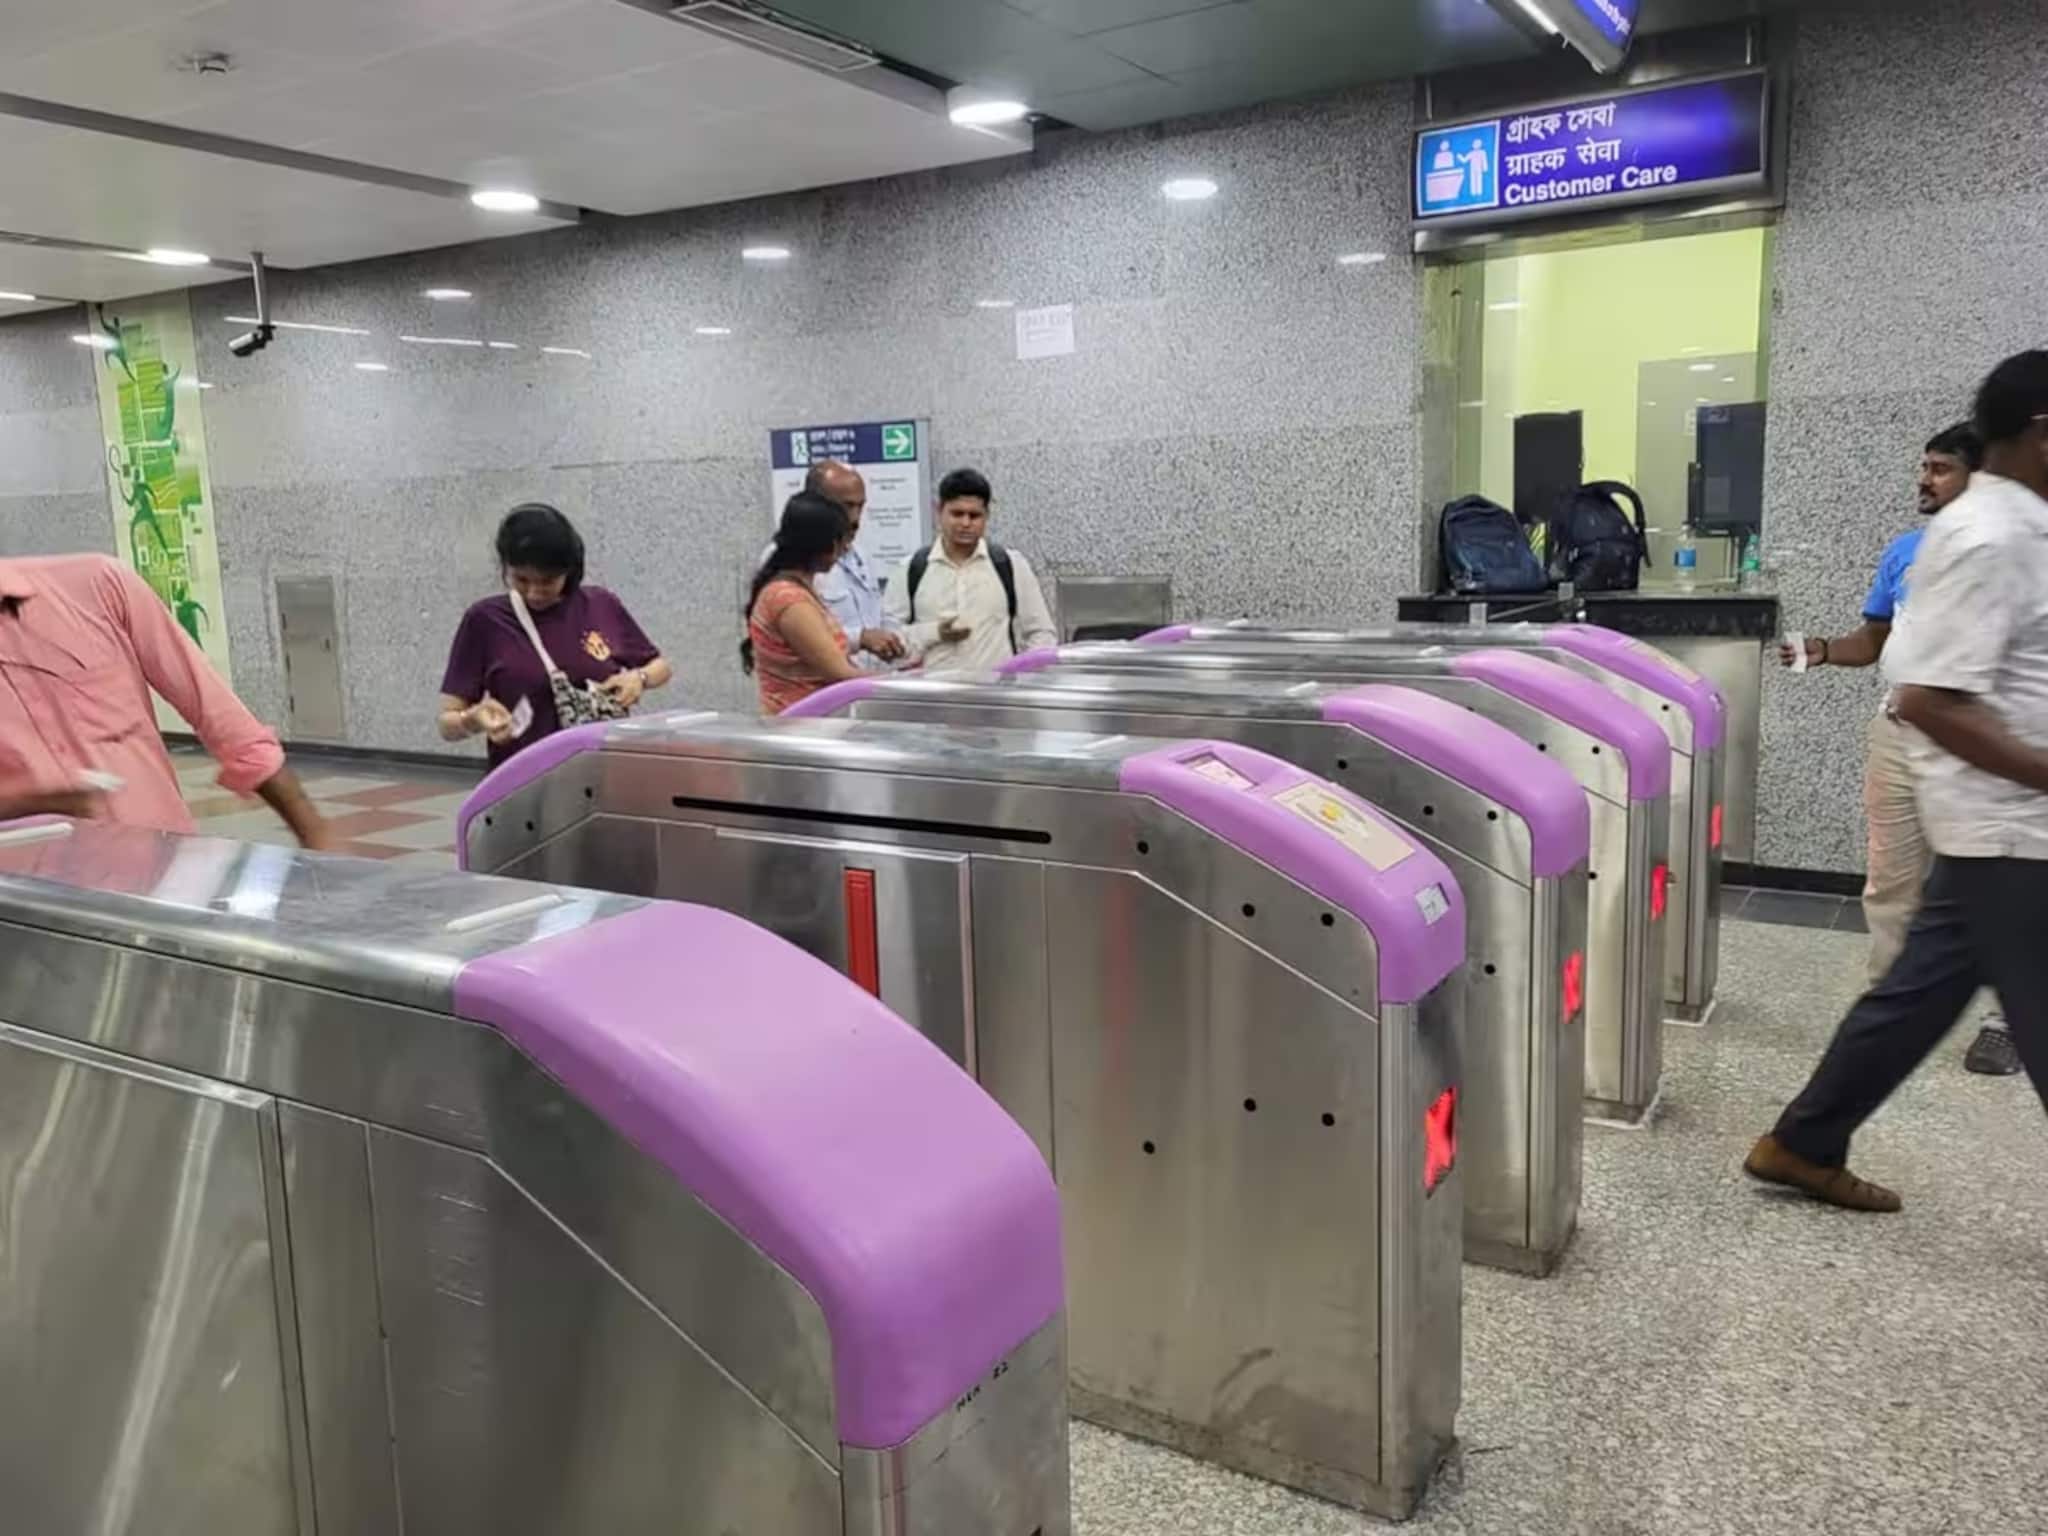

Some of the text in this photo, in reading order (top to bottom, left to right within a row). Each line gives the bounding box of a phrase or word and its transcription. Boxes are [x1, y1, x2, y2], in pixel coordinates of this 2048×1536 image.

[1506, 102, 1616, 144] গ্রাহক সেবা
[1505, 138, 1622, 176] ग्राहक सेवा
[1505, 164, 1678, 205] Customer Care
